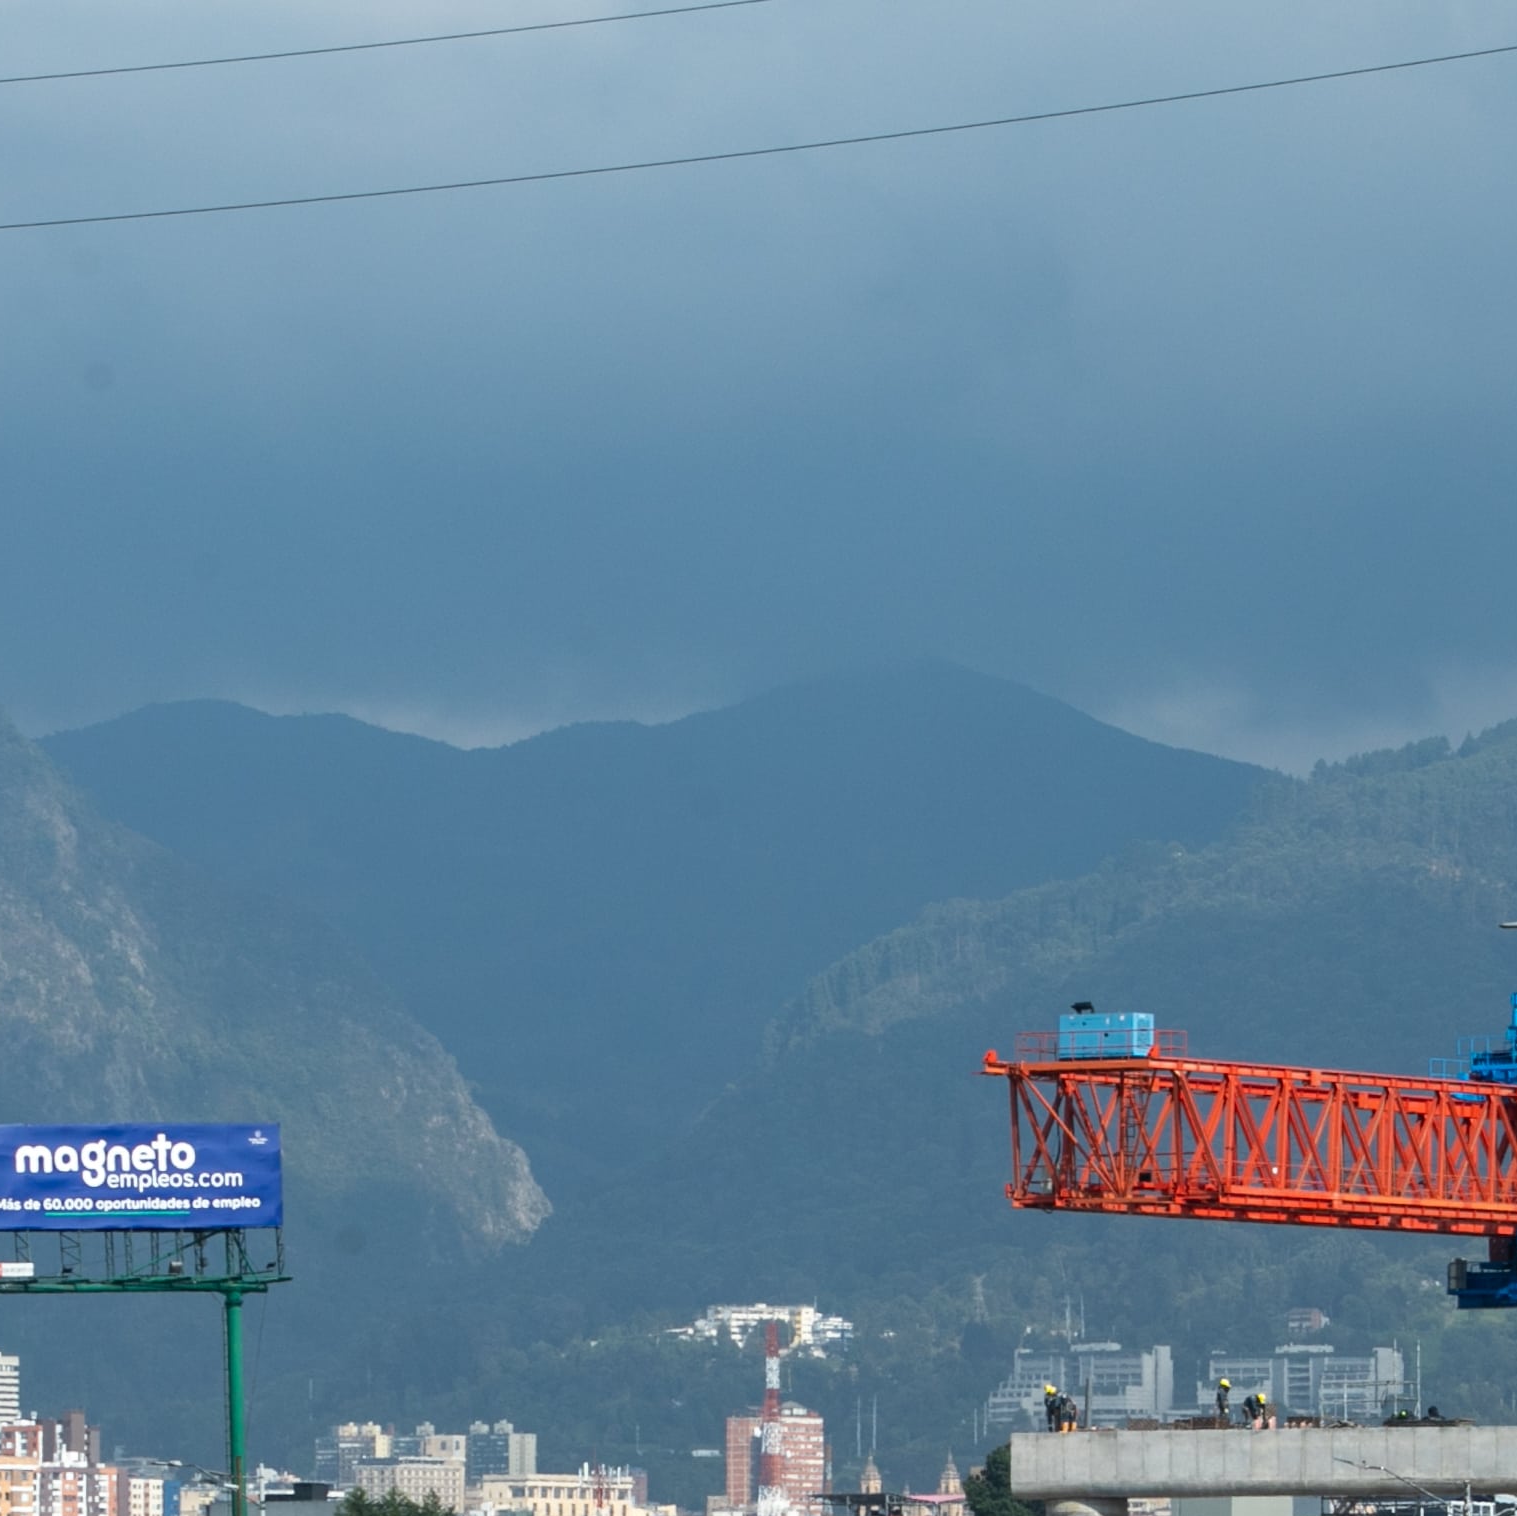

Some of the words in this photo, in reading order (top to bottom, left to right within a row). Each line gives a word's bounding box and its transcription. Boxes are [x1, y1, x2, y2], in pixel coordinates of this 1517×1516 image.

[15, 1133, 196, 1188] magneto
[107, 1170, 243, 1193] empleos.com
[24, 1198, 41, 1211] de
[43, 1198, 94, 1211] 60.000
[95, 1197, 191, 1213] oportunidades
[193, 1197, 210, 1210] de
[213, 1196, 261, 1212] empleo
